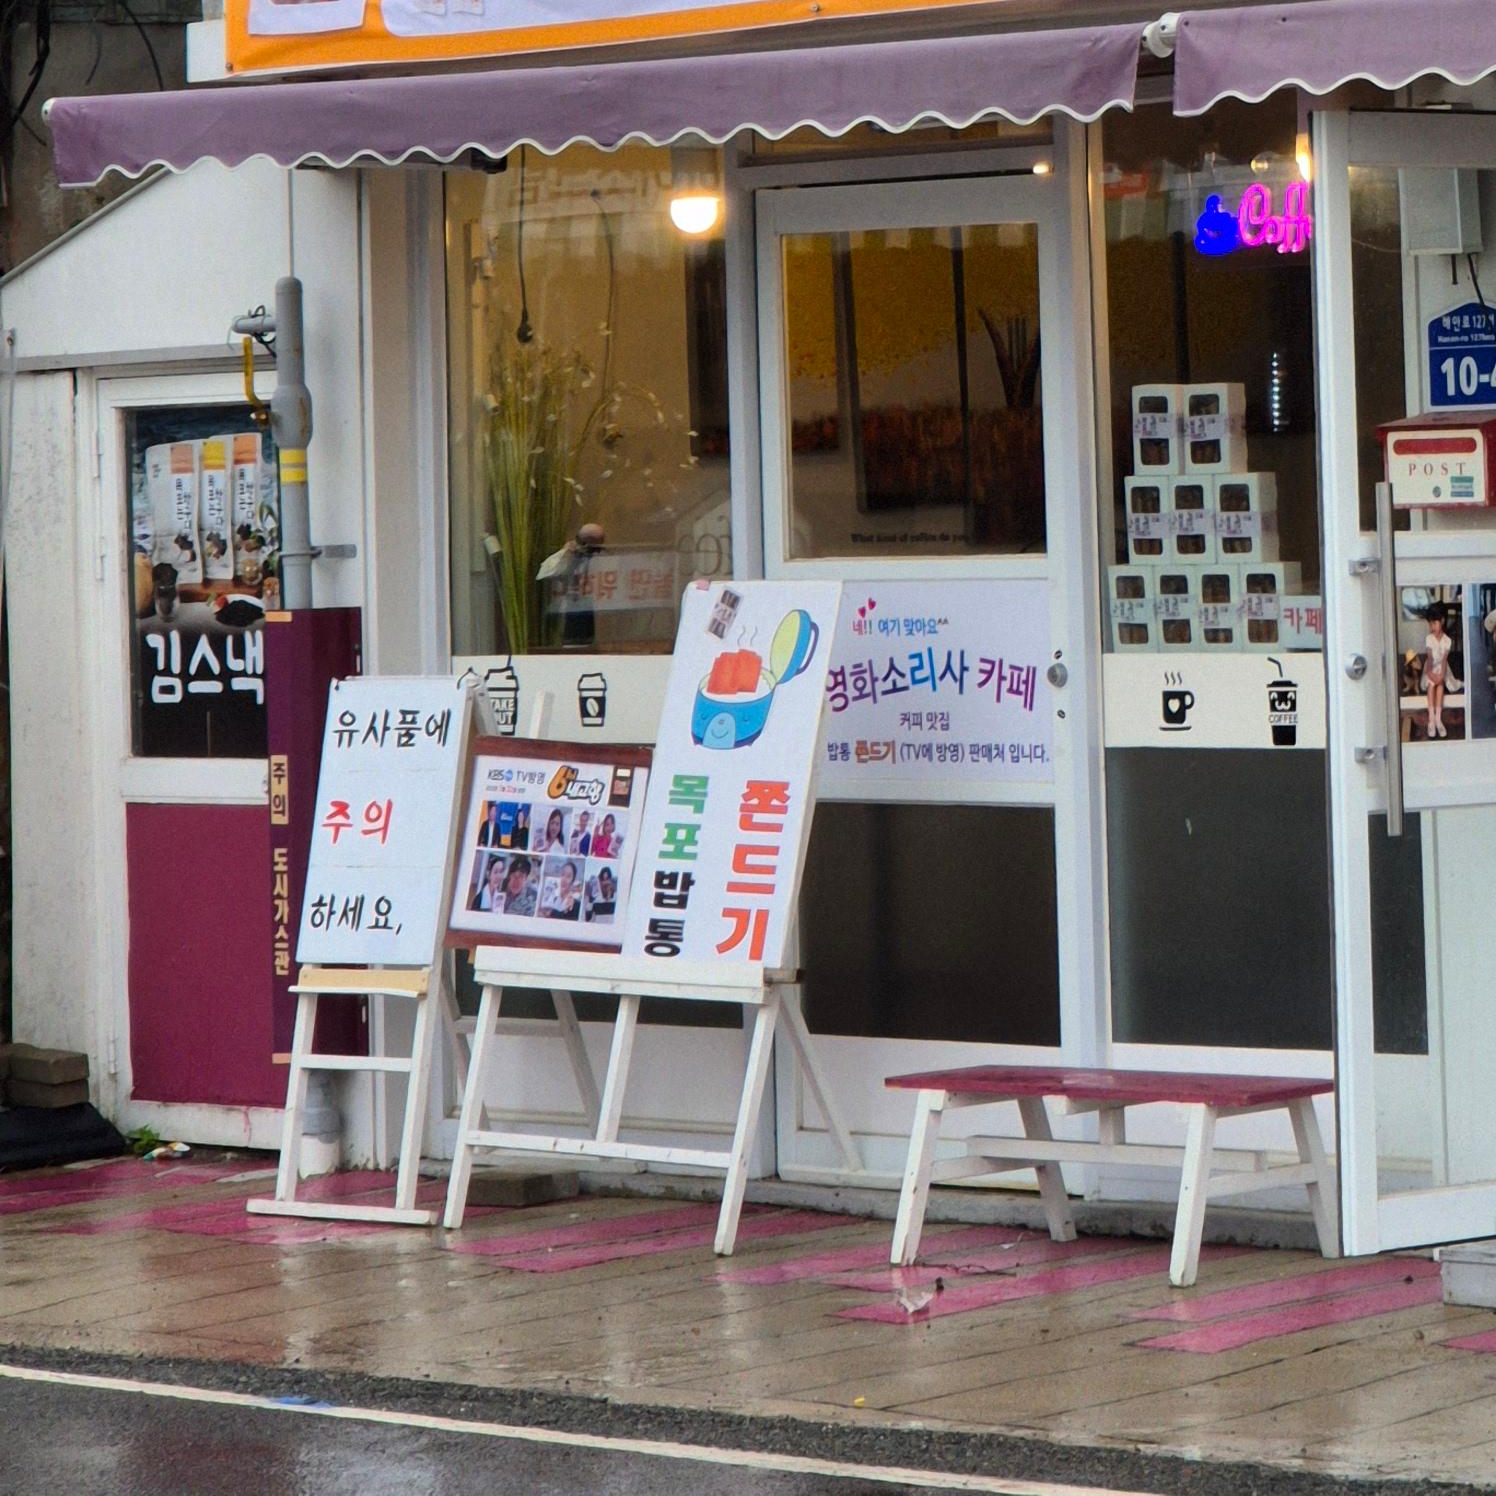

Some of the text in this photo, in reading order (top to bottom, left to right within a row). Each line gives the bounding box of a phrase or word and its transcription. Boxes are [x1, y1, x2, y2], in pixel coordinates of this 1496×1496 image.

[1238, 180, 1312, 253] Coff
[1408, 461, 1467, 476] POST
[852, 618, 873, 636] 네!!
[877, 619, 901, 636] 여기
[1283, 607, 1323, 635] 카페
[146, 628, 265, 705] 김스낵
[825, 646, 1037, 713] 영화소리사 카페
[497, 712, 513, 725] UT
[899, 711, 950, 732] 커피 맛집
[1268, 713, 1299, 724] COFFEE
[827, 740, 851, 762] 밥통
[855, 739, 897, 765] 쫀드기
[271, 760, 289, 818] 주의
[321, 798, 394, 846] 주의
[716, 779, 791, 962] 쫀드기
[271, 847, 290, 976] 도시가스관
